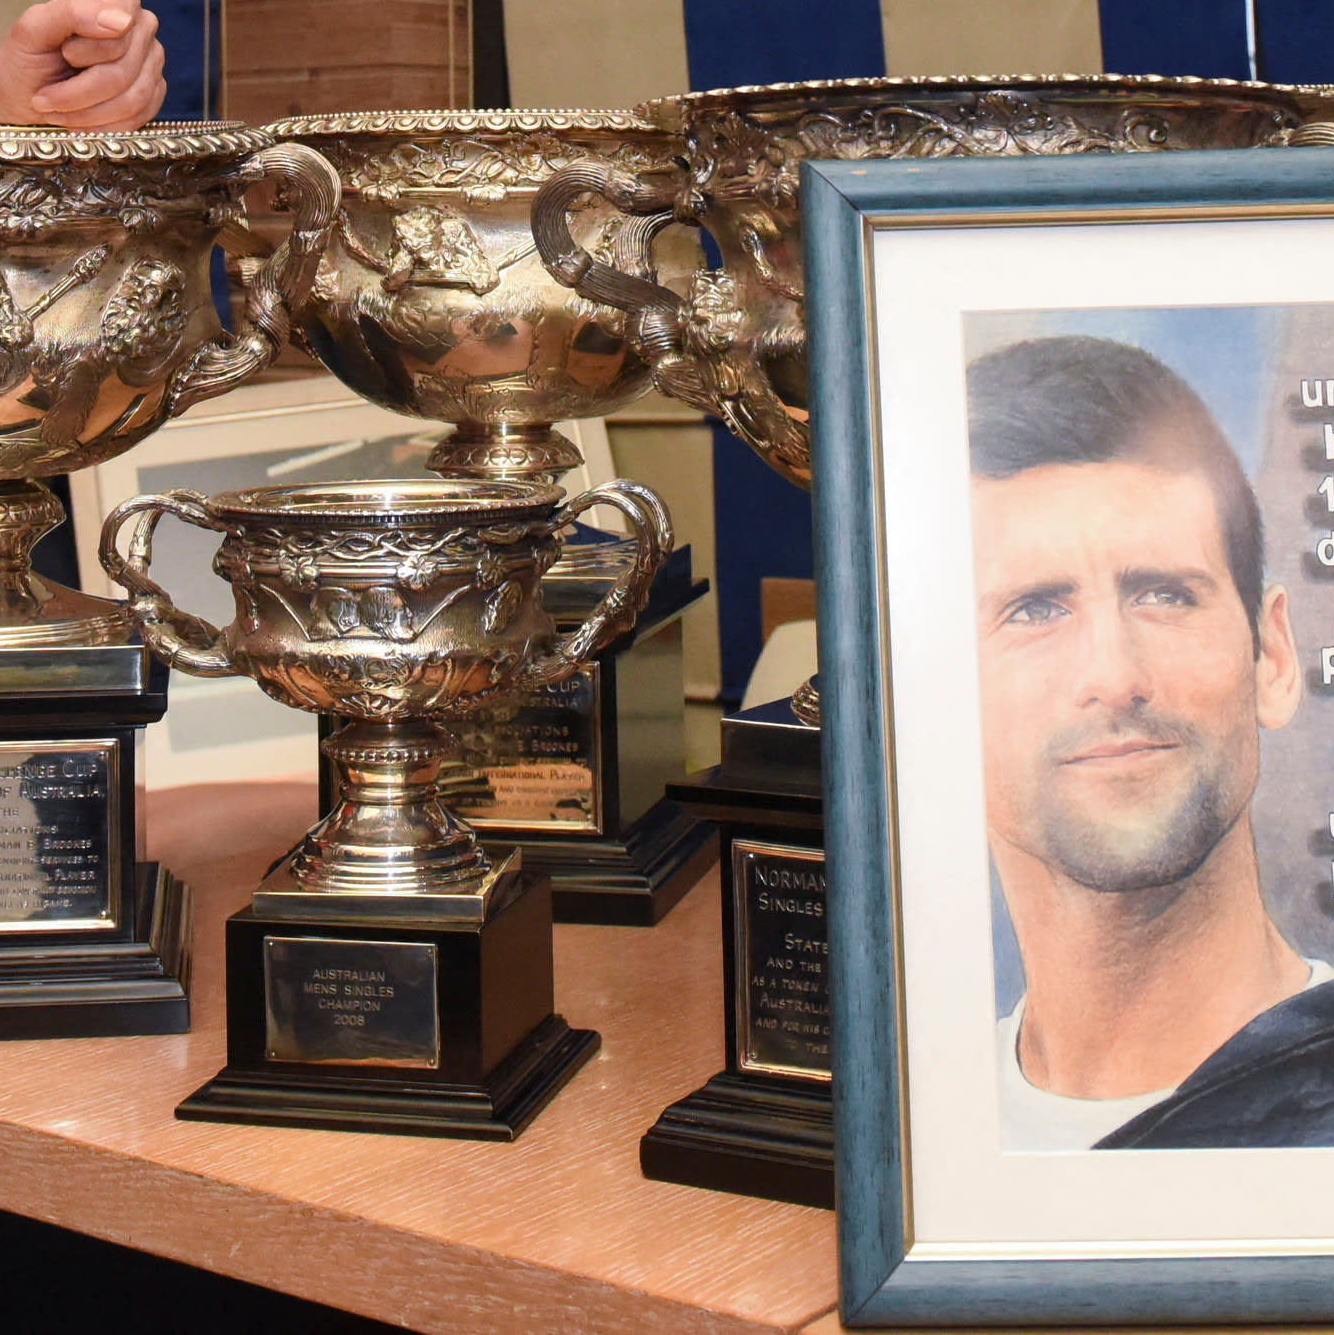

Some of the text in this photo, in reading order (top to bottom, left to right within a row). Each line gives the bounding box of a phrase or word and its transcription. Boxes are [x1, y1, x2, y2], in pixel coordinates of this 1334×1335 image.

[546, 680, 580, 693] CUP
[62, 759, 98, 778] CUP
[758, 892, 824, 917] SINGLES
[785, 933, 828, 955] STATE
[767, 956, 821, 973] AND THE
[312, 969, 385, 983] AUSTRALIAN
[303, 982, 395, 998] MENS SINGLES
[318, 998, 381, 1011] CHAMPION
[333, 1014, 365, 1026] 2008
